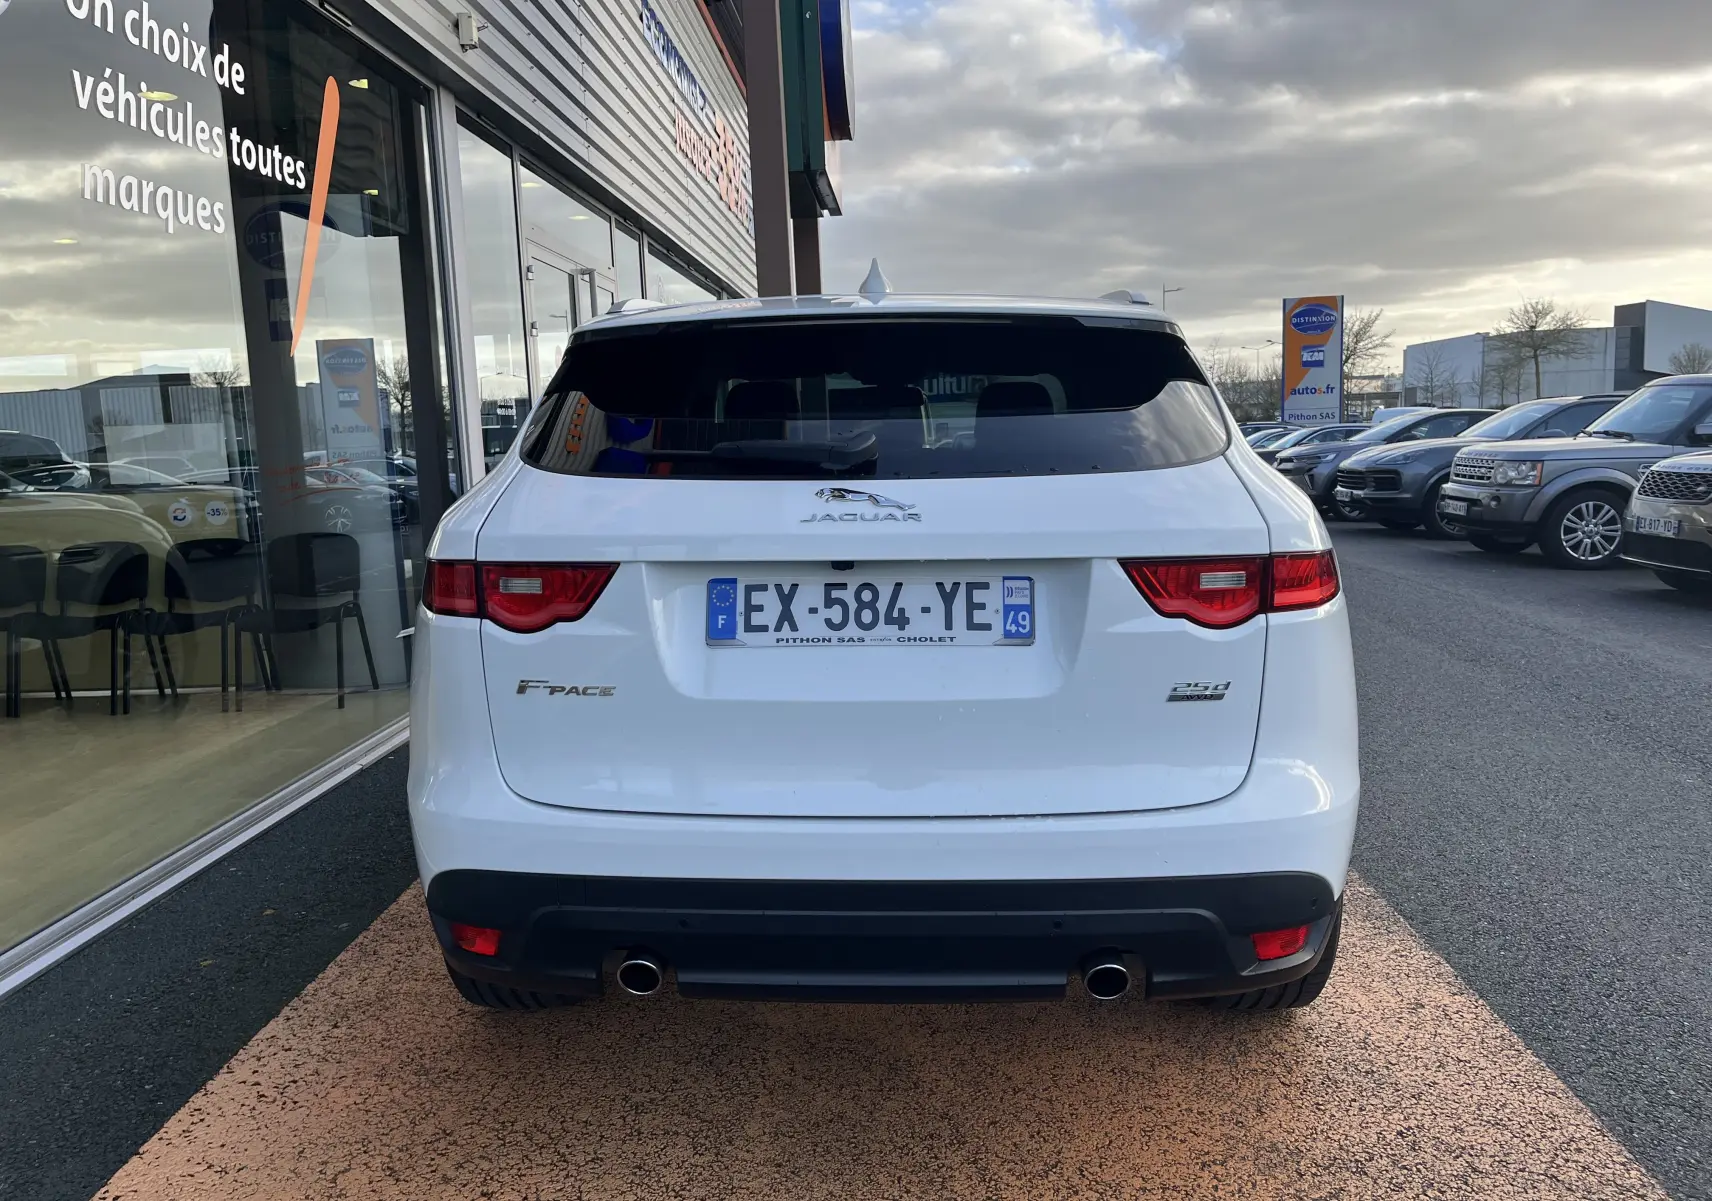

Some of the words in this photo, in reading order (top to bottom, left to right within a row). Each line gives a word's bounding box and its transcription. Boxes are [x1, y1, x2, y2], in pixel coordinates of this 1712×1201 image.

[124, 1, 207, 77] choix
[214, 43, 245, 95] de
[72, 67, 224, 158] véhicules
[230, 127, 306, 190] toutes
[83, 163, 226, 234] marques
[1291, 315, 1336, 324] DISTINXION
[1290, 384, 1335, 396] autos.fr
[1288, 413, 1317, 421] Pithon
[1319, 412, 1336, 420] SAS
[206, 508, 228, 517] -35%
[800, 513, 923, 523] JAGUAR
[717, 615, 727, 629] F
[743, 581, 993, 633] EX-584-YE
[1005, 611, 1031, 634] 49
[1171, 680, 1232, 692] 25d
